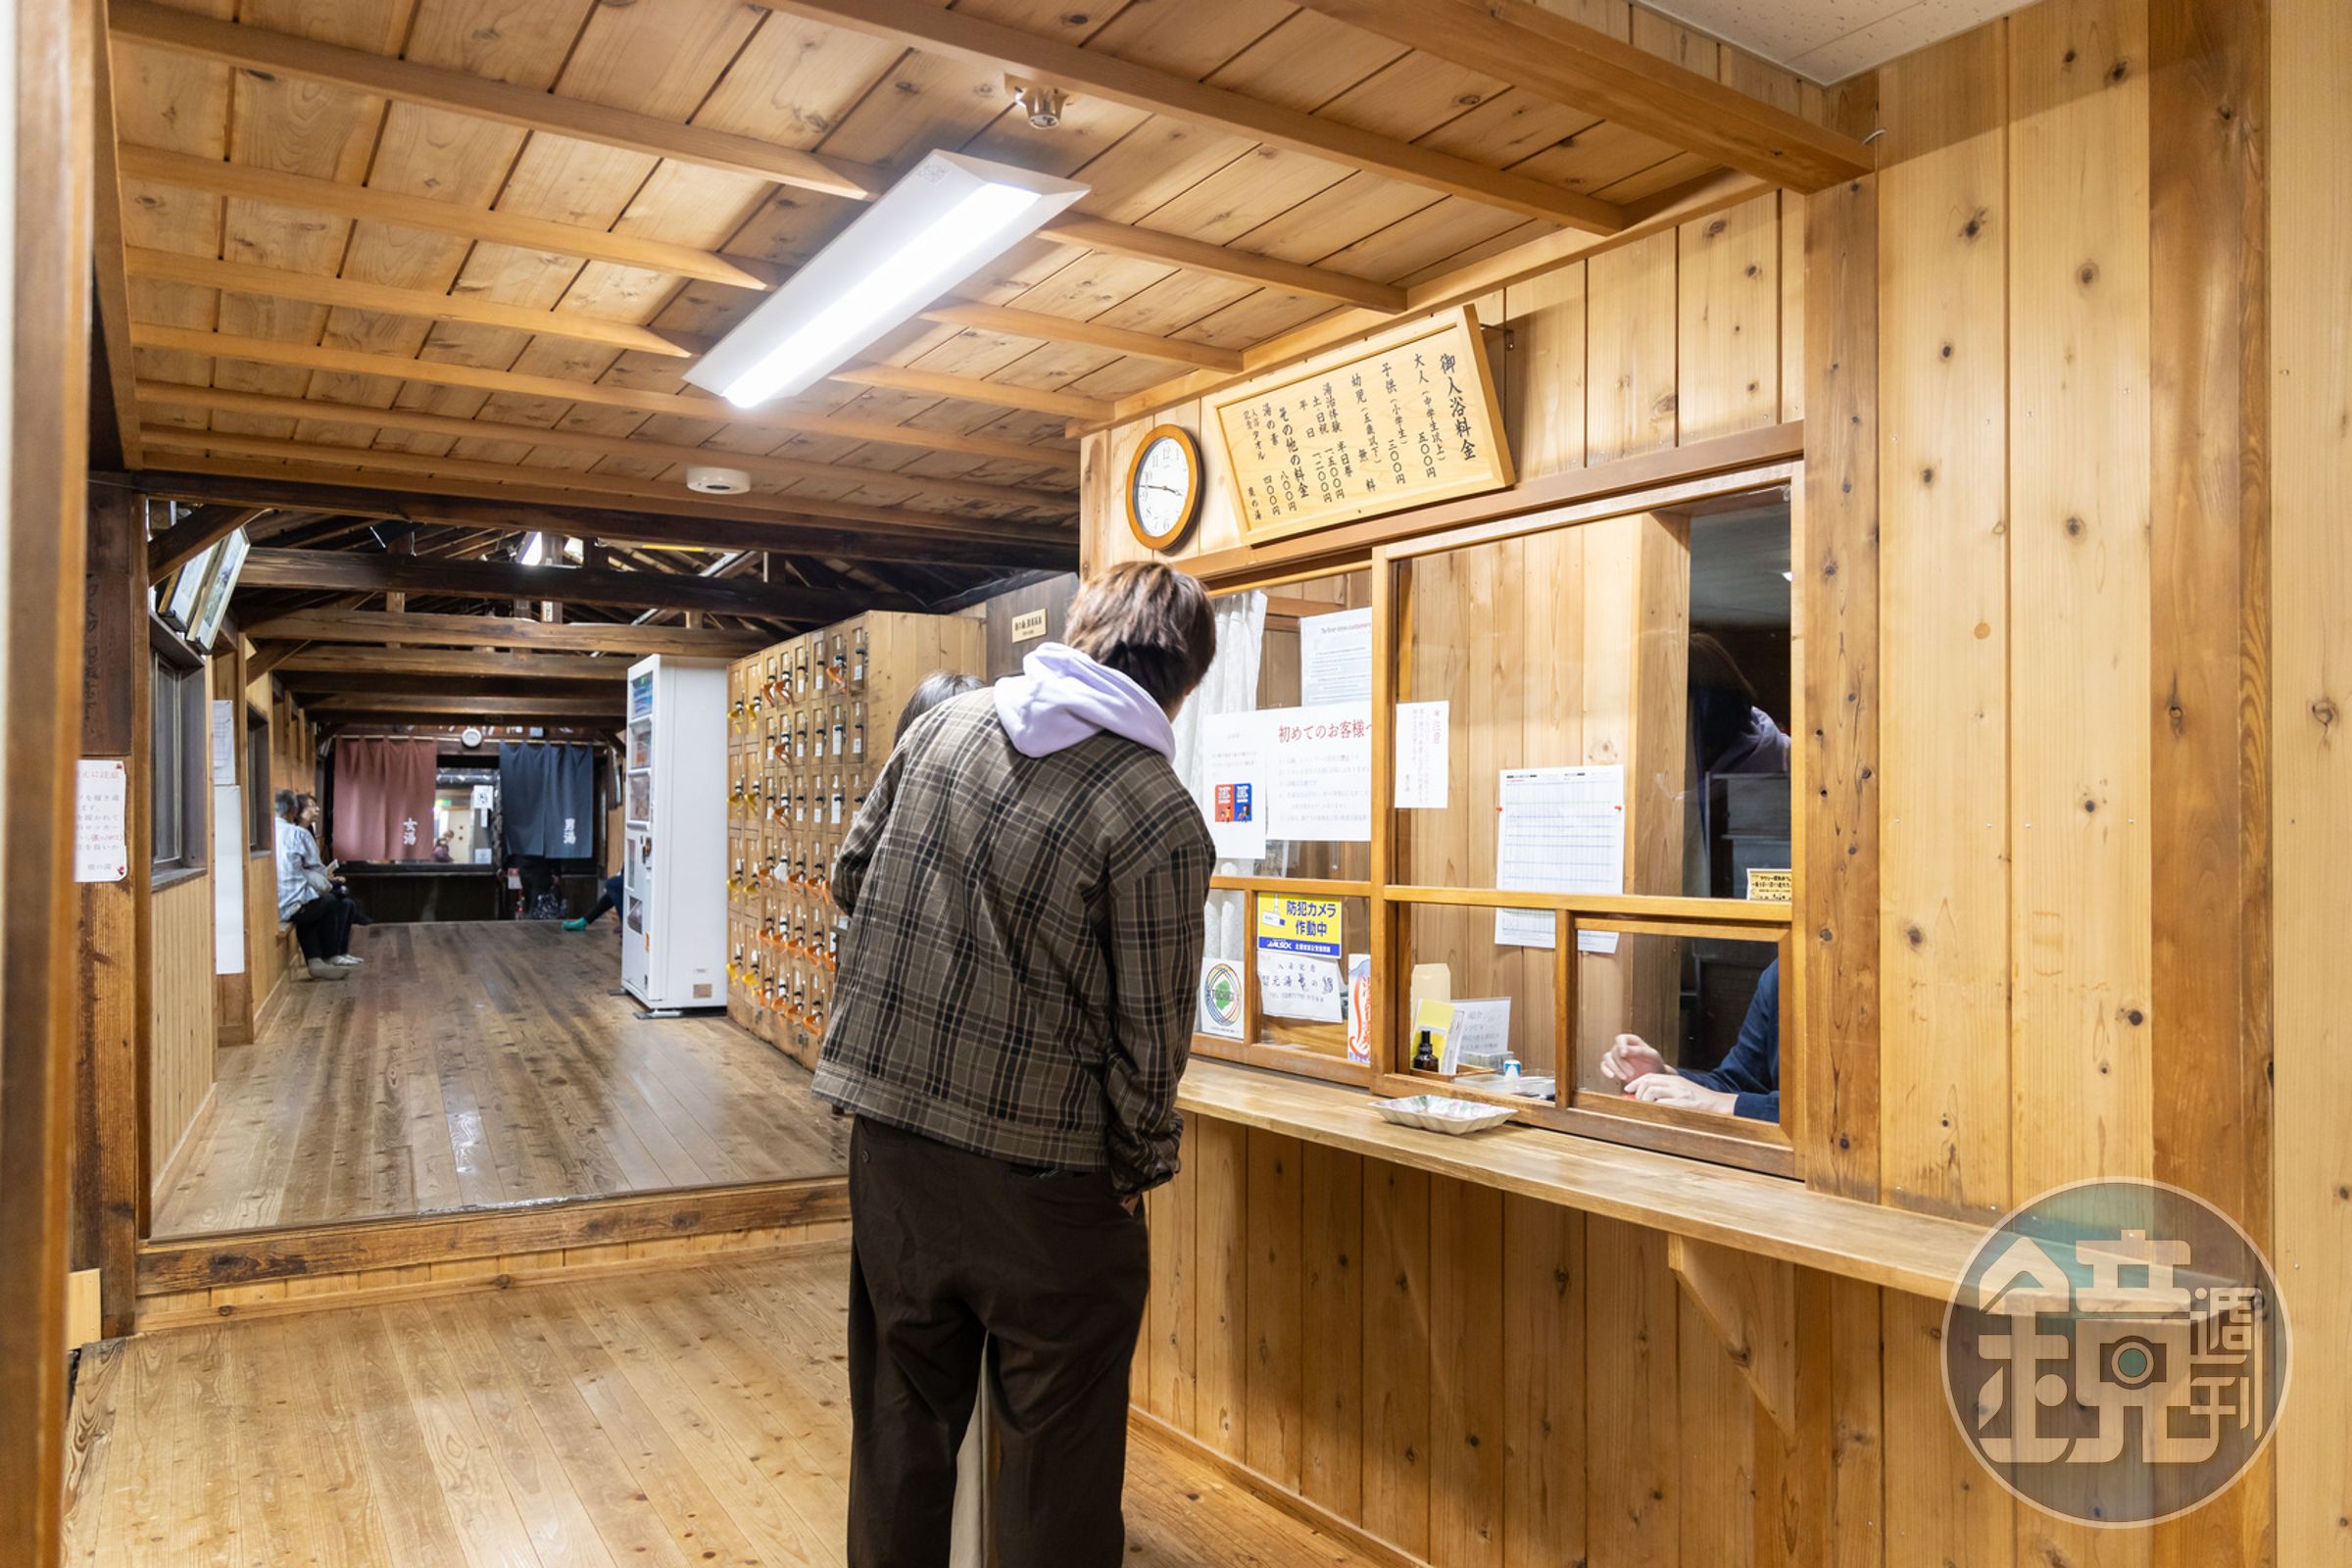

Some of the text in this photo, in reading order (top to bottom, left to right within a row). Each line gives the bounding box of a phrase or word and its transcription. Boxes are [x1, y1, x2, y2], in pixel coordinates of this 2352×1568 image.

[1440, 353, 1477, 461] 御入浴料金
[1280, 407, 1309, 499] その他の料金
[403, 817, 418, 846] 女湯
[1287, 900, 1337, 918] 防犯カメラ
[1296, 919, 1327, 937] 作動中
